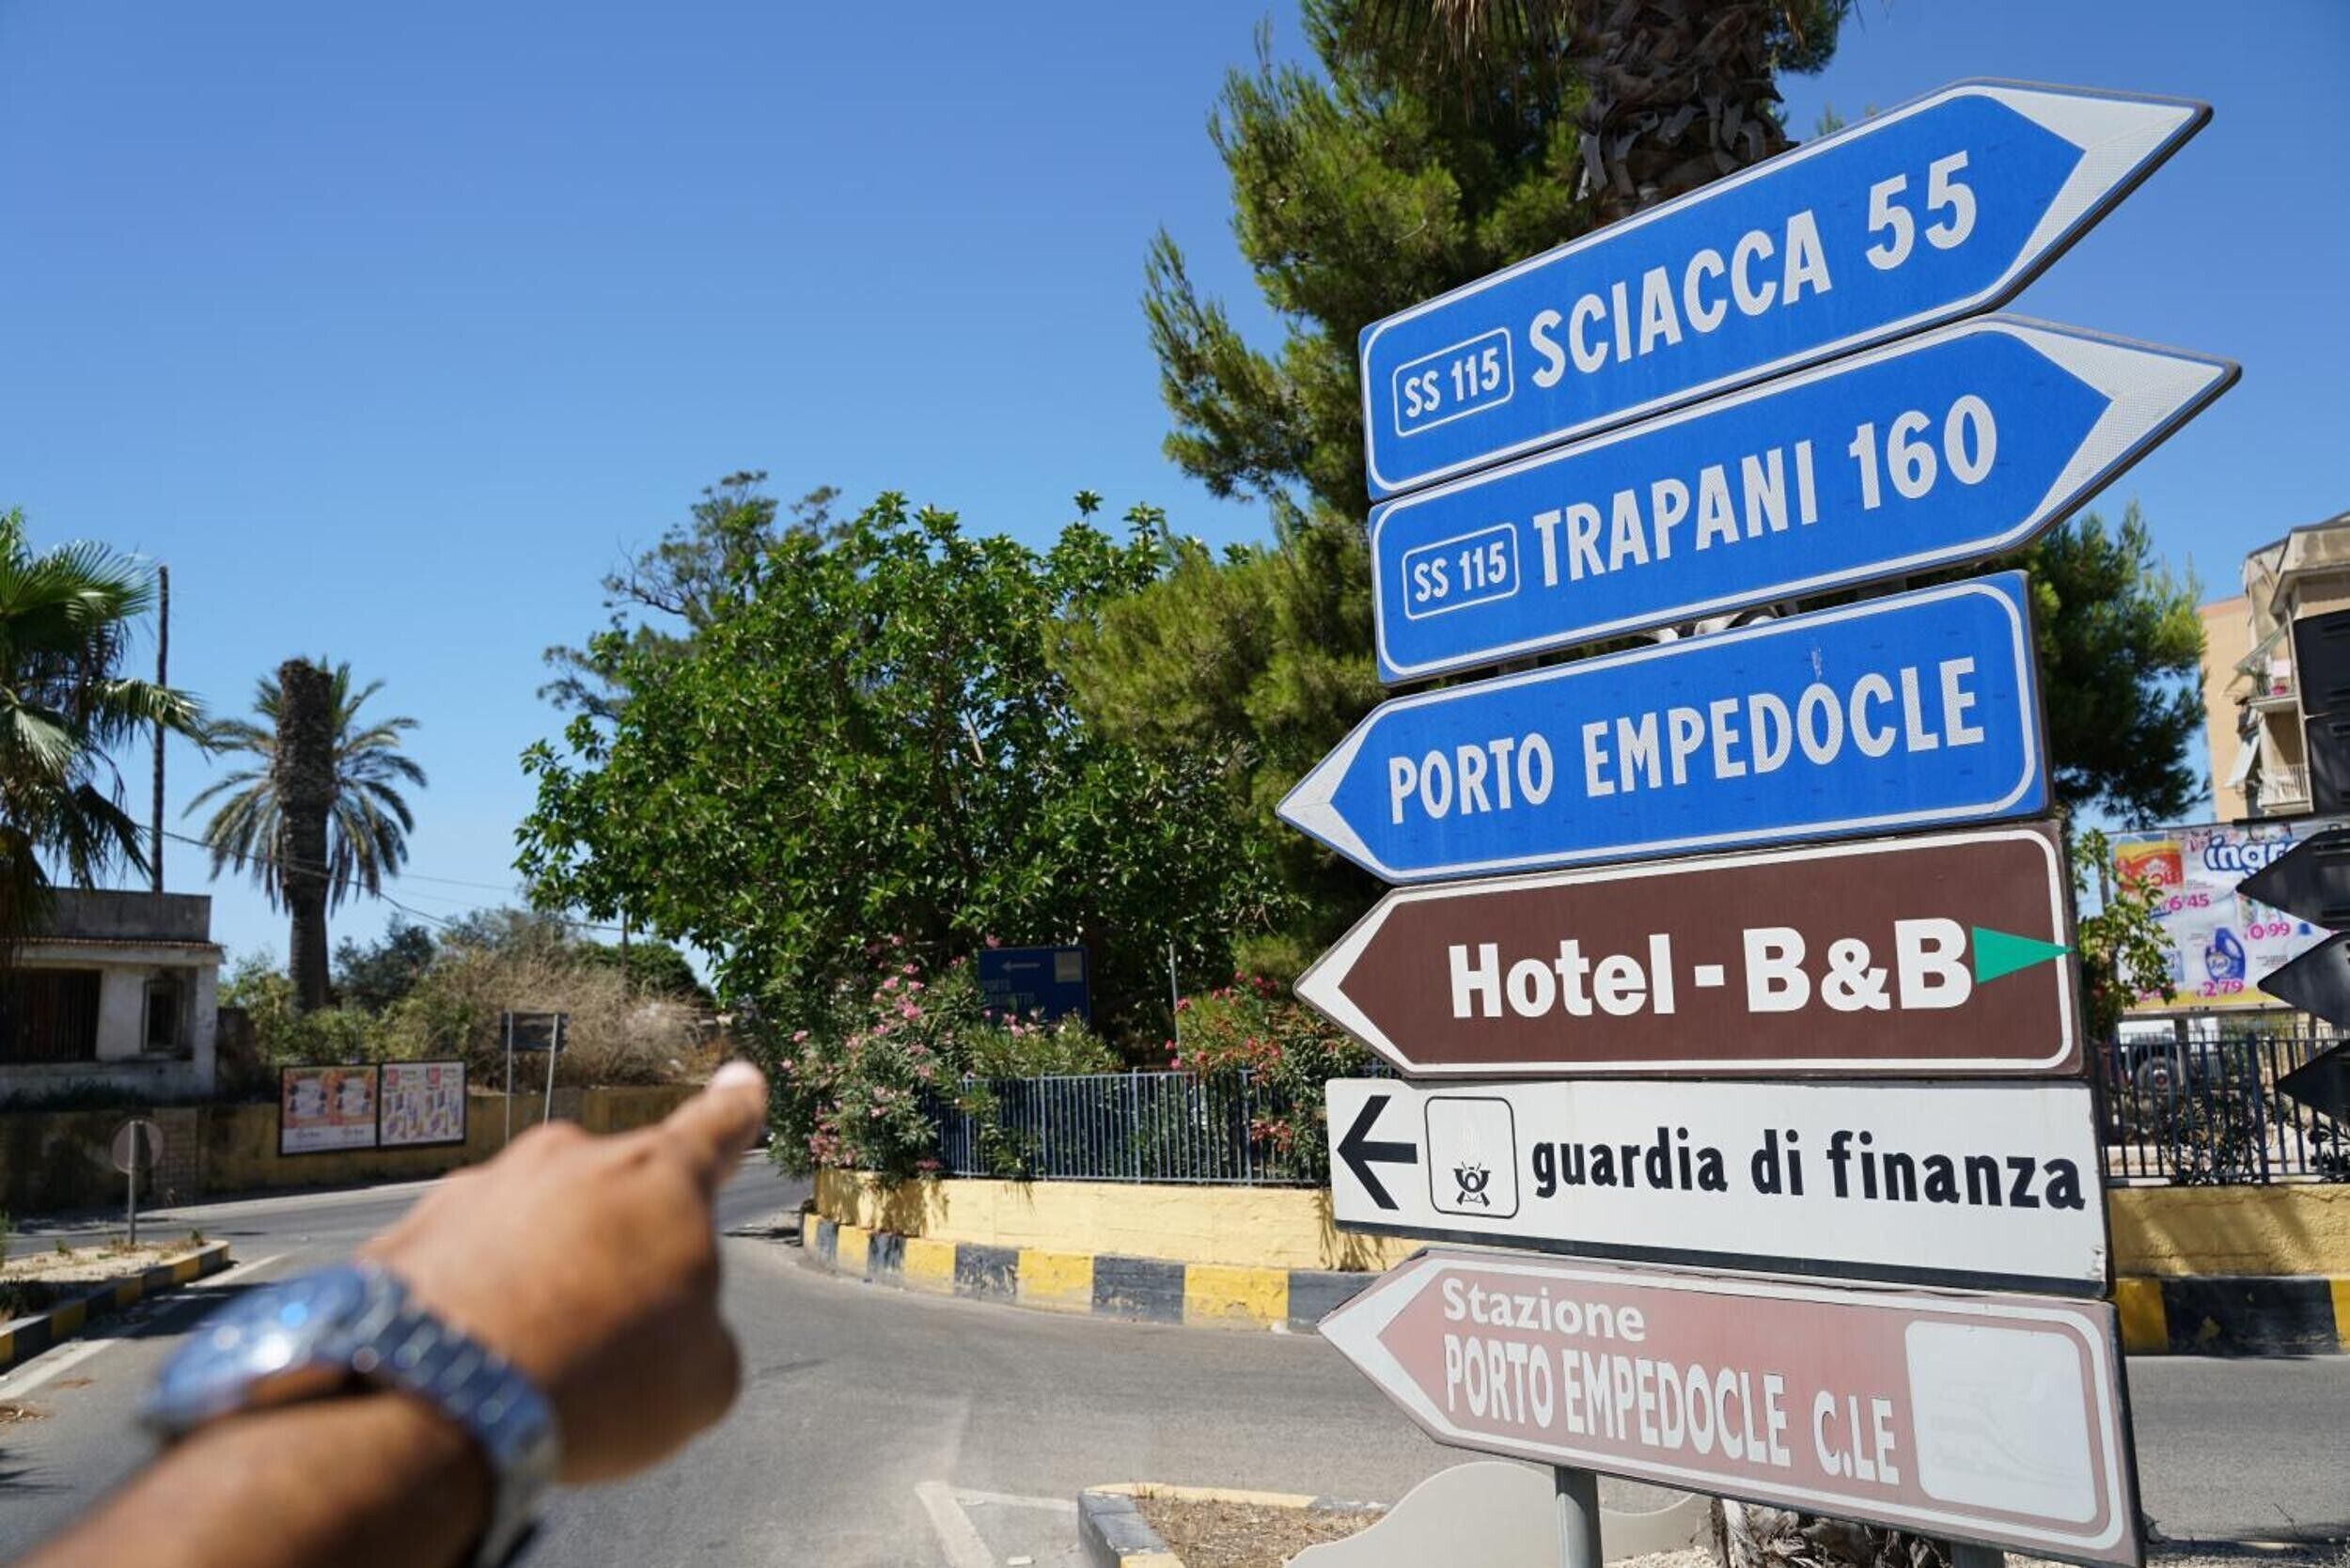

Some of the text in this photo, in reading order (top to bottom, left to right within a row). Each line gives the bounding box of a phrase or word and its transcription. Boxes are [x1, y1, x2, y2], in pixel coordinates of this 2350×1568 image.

[1528, 149, 1977, 388] SCIACCA 55
[1404, 347, 1501, 418] SS 115
[1532, 394, 1998, 588] TRAPANI 160
[1414, 541, 1507, 603] SS 115
[1388, 656, 1984, 824] PORTO EMPEDOCLE
[2204, 834, 2304, 877] ingr
[1449, 933, 1675, 1018] Hotel
[1743, 917, 1972, 1012] B&B
[1531, 1126, 2086, 1211] guardia di finanza
[1441, 1277, 1647, 1342] Stazione
[1444, 1333, 1900, 1485] PORTO EMPEDOCLE C.LE
